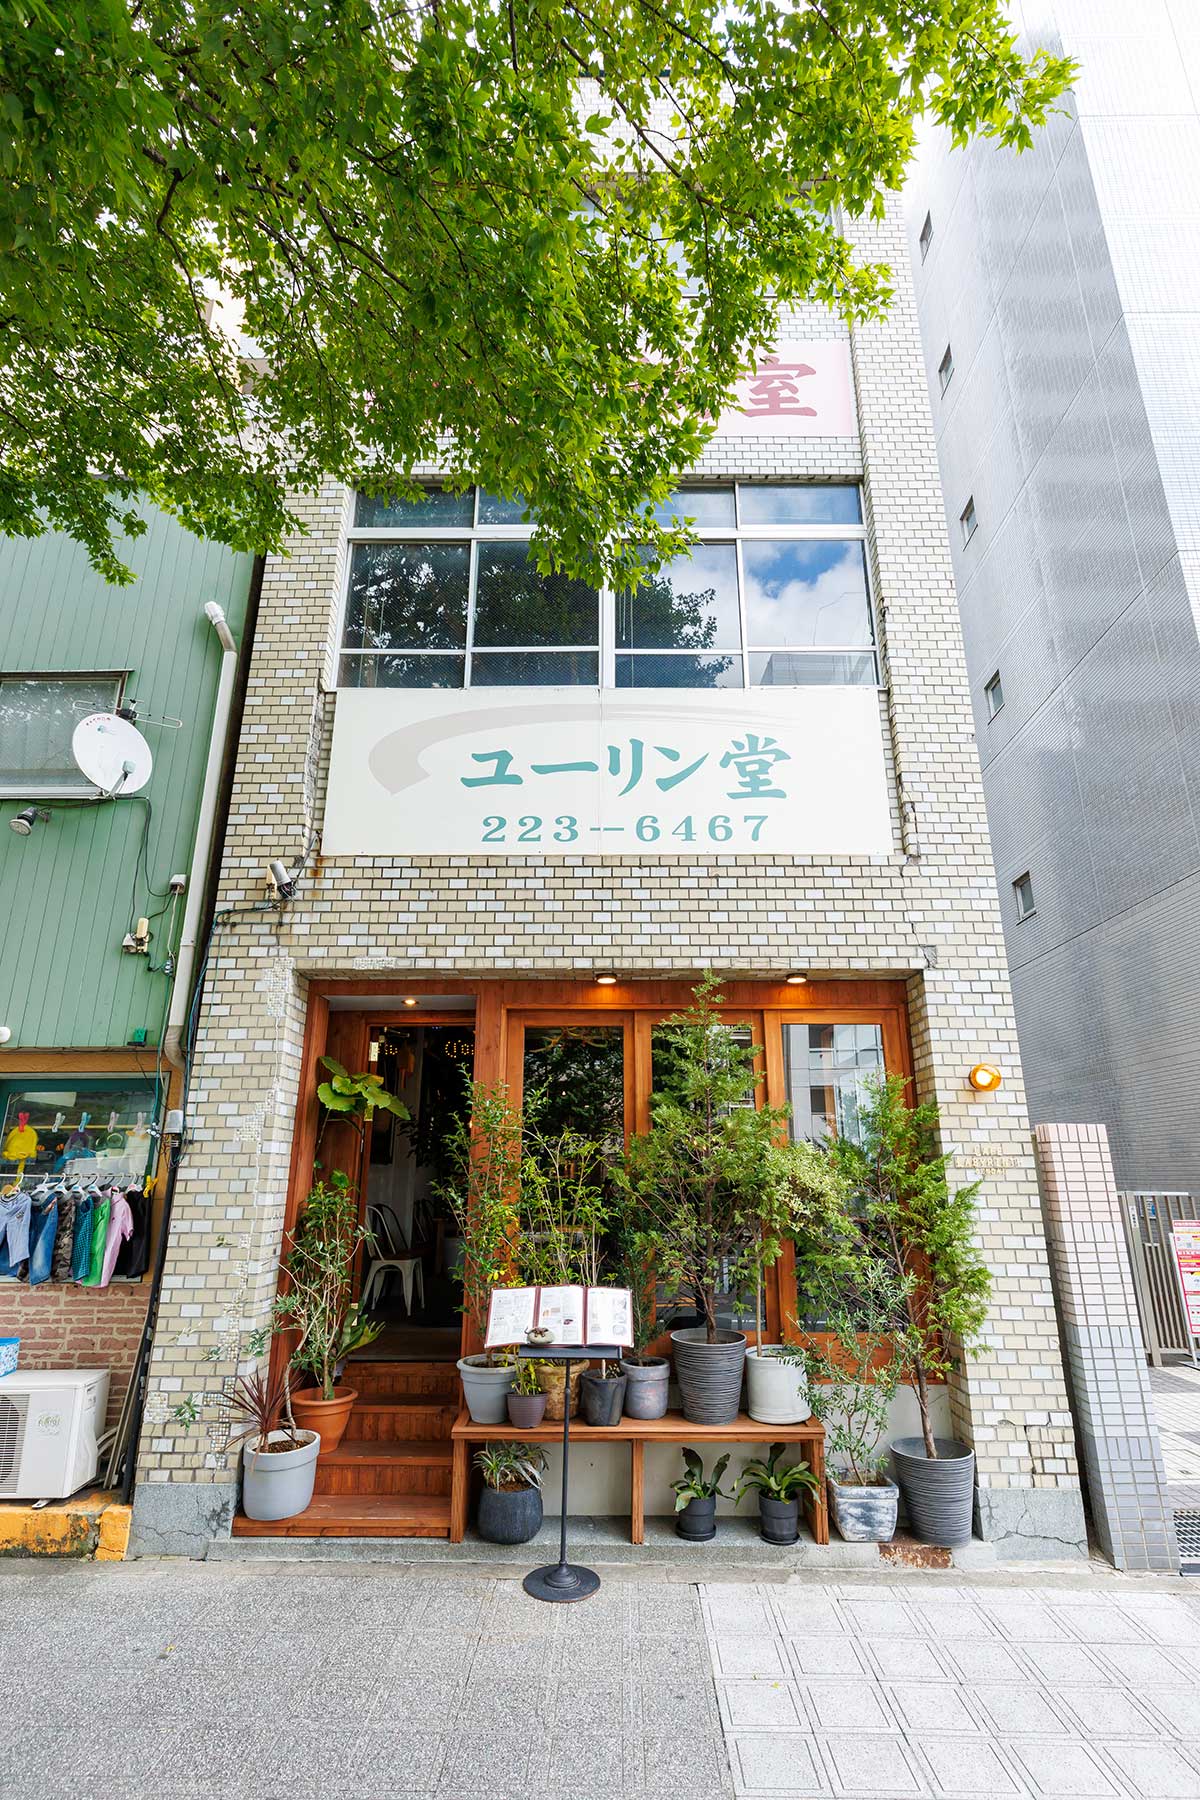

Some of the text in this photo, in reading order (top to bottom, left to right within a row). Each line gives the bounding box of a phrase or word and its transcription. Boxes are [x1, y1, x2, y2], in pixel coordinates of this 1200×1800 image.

[460, 733, 792, 800] ユーリン堂
